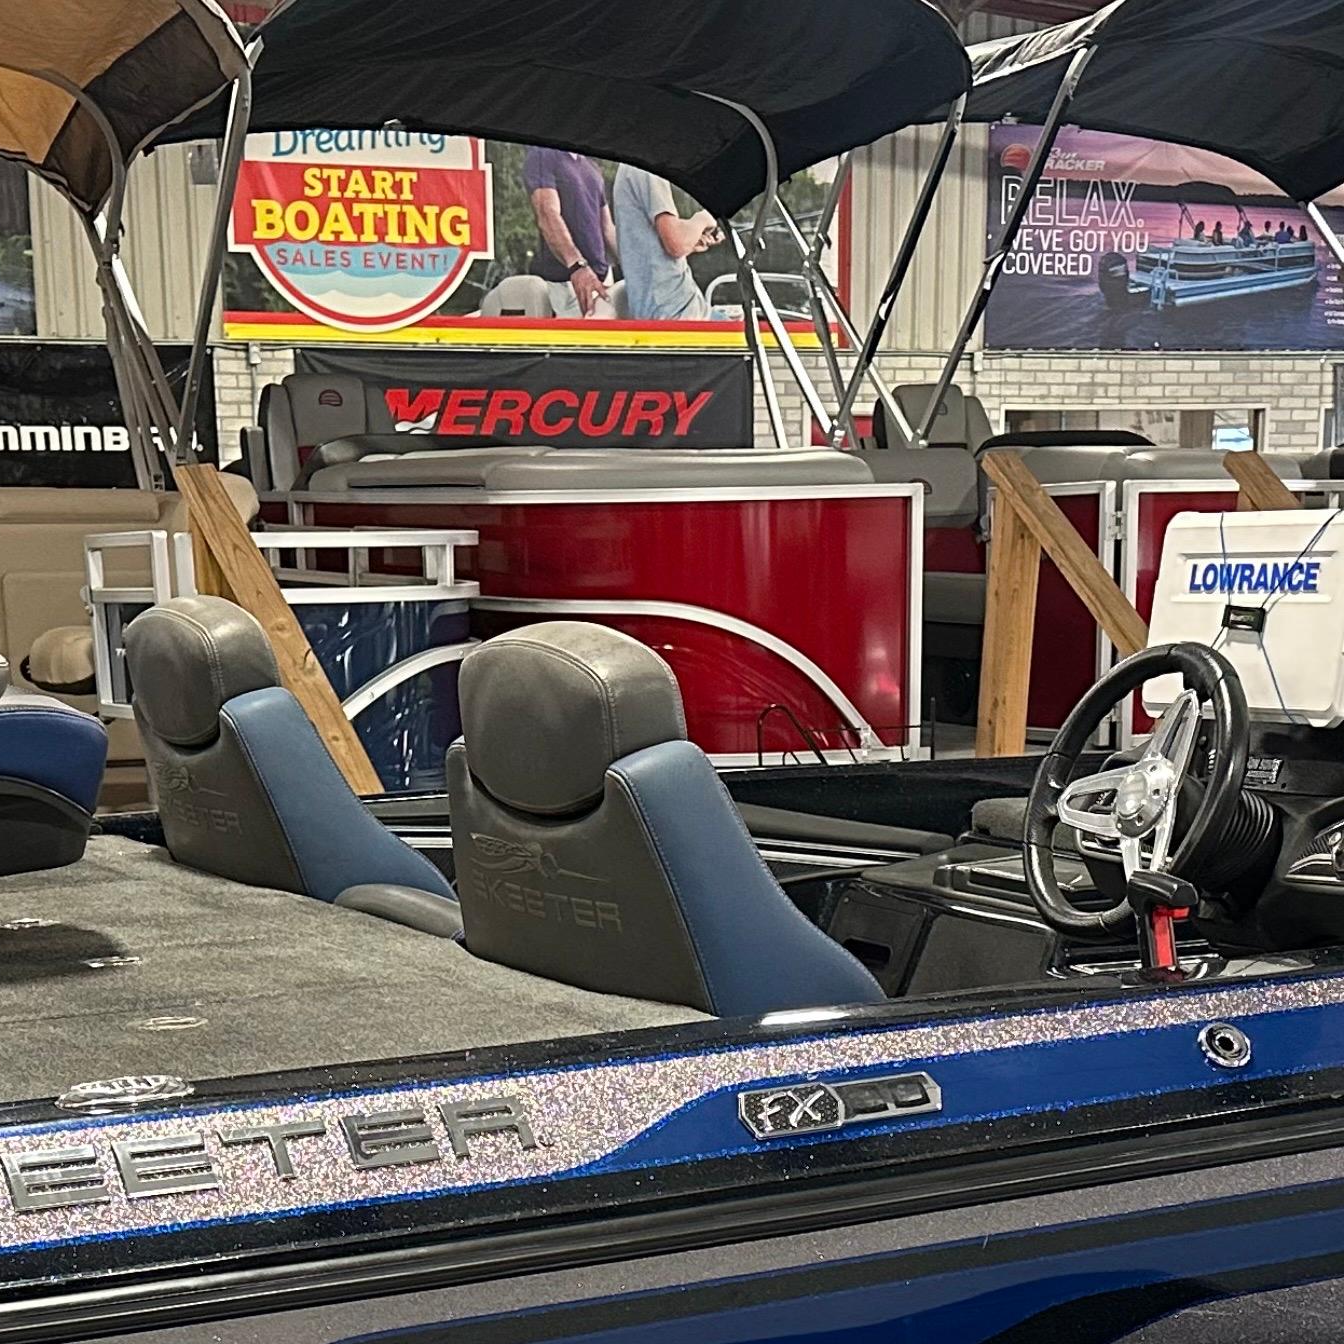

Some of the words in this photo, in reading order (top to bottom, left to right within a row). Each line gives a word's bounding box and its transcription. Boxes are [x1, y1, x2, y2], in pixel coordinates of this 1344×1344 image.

[1044, 158, 1105, 172] RACKER
[303, 167, 418, 201] START
[1001, 175, 1144, 228] RELAX.
[250, 198, 471, 246] BOATING
[1069, 229, 1107, 252] GOT
[1109, 230, 1149, 253] YOU
[275, 248, 352, 268] SALES
[363, 251, 449, 271] EVENT!
[1002, 252, 1093, 276] COVERED
[384, 388, 714, 437] MERCURY
[1189, 561, 1321, 594] LOWRANCE
